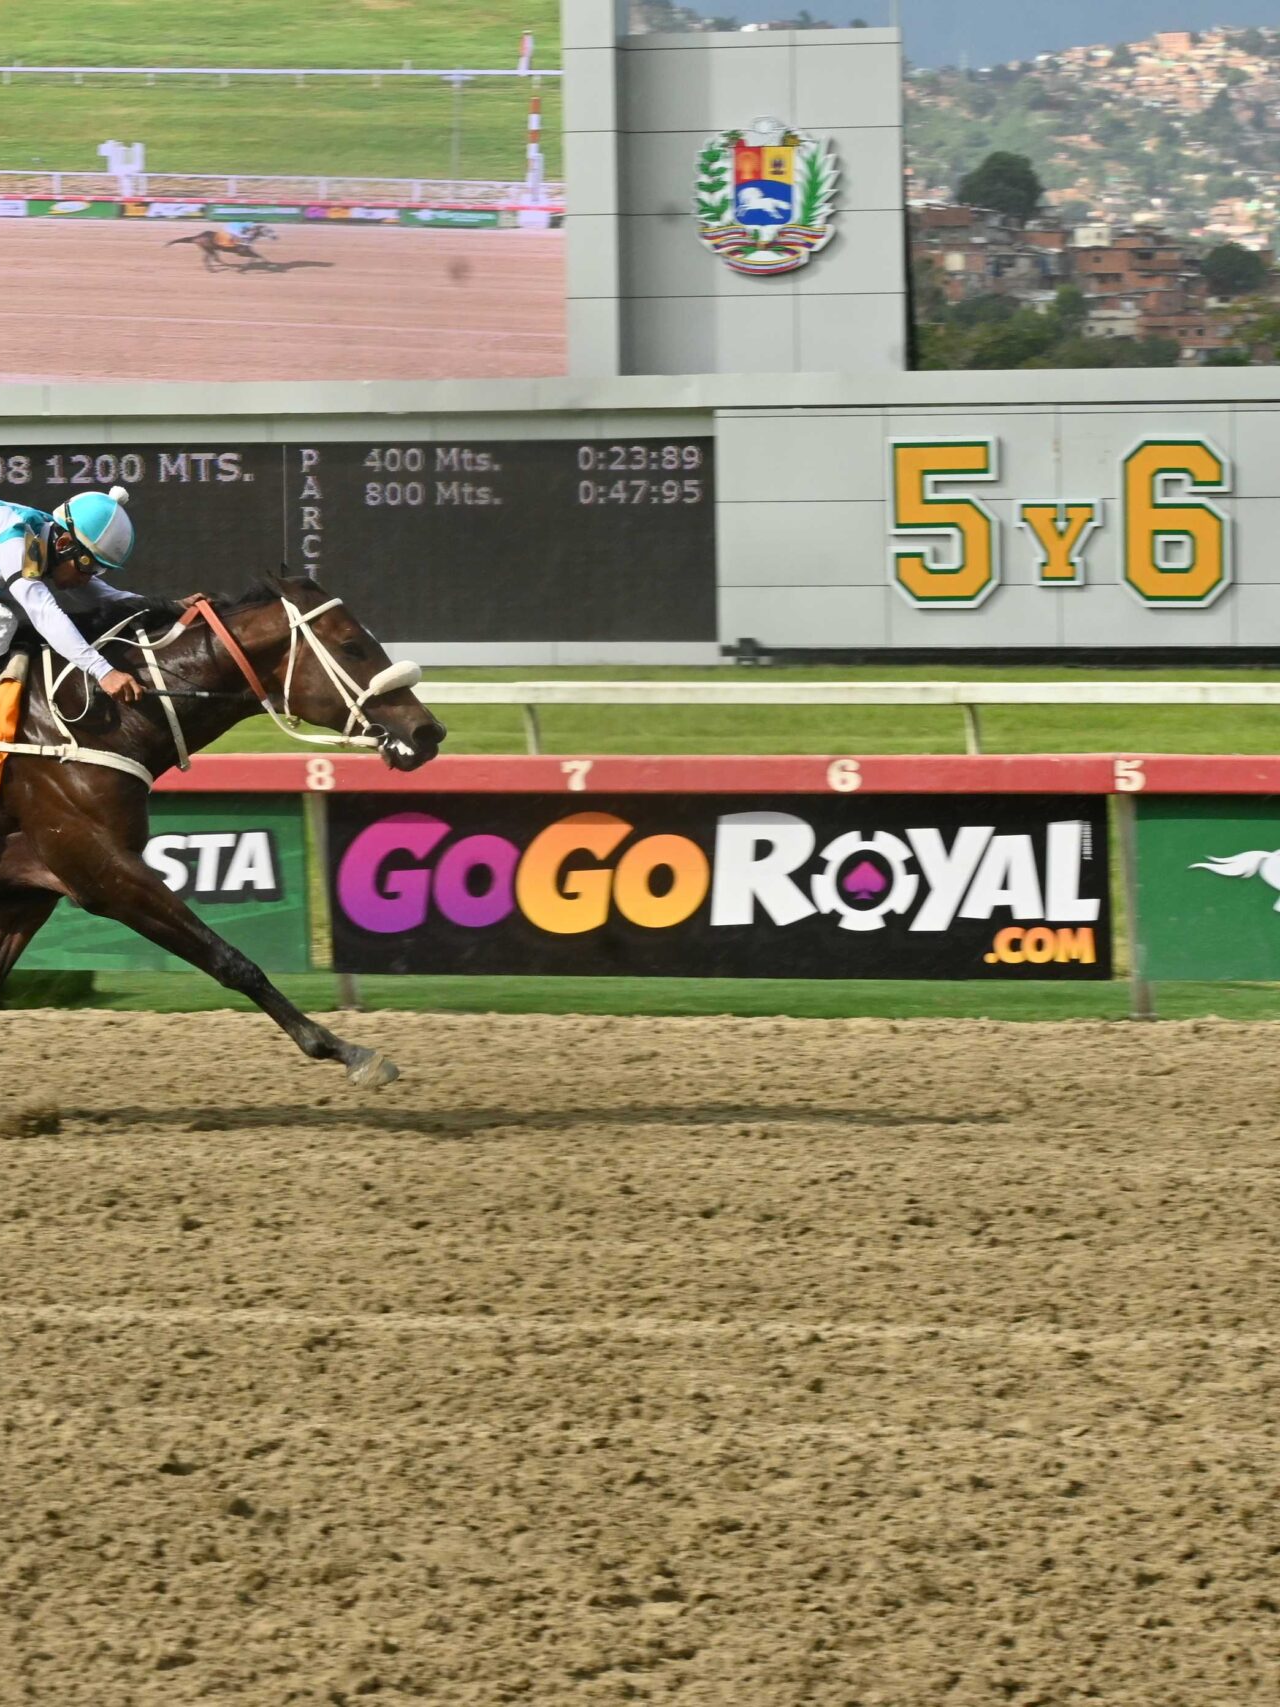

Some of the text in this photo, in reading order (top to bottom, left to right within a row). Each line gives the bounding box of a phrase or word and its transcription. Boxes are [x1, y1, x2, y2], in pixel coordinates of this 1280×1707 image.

[46, 453, 146, 484] 1200
[158, 452, 255, 482] MTS.
[363, 446, 703, 472] 400 Mts. 0:23:89
[365, 479, 704, 505] 800 Mts. 0:47:95
[889, 434, 1232, 608] 5 Y 6
[306, 759, 336, 791] 8
[561, 760, 593, 791] 7
[827, 759, 862, 792] 6
[1114, 760, 1146, 792] 5
[983, 926, 1097, 964] .COM
